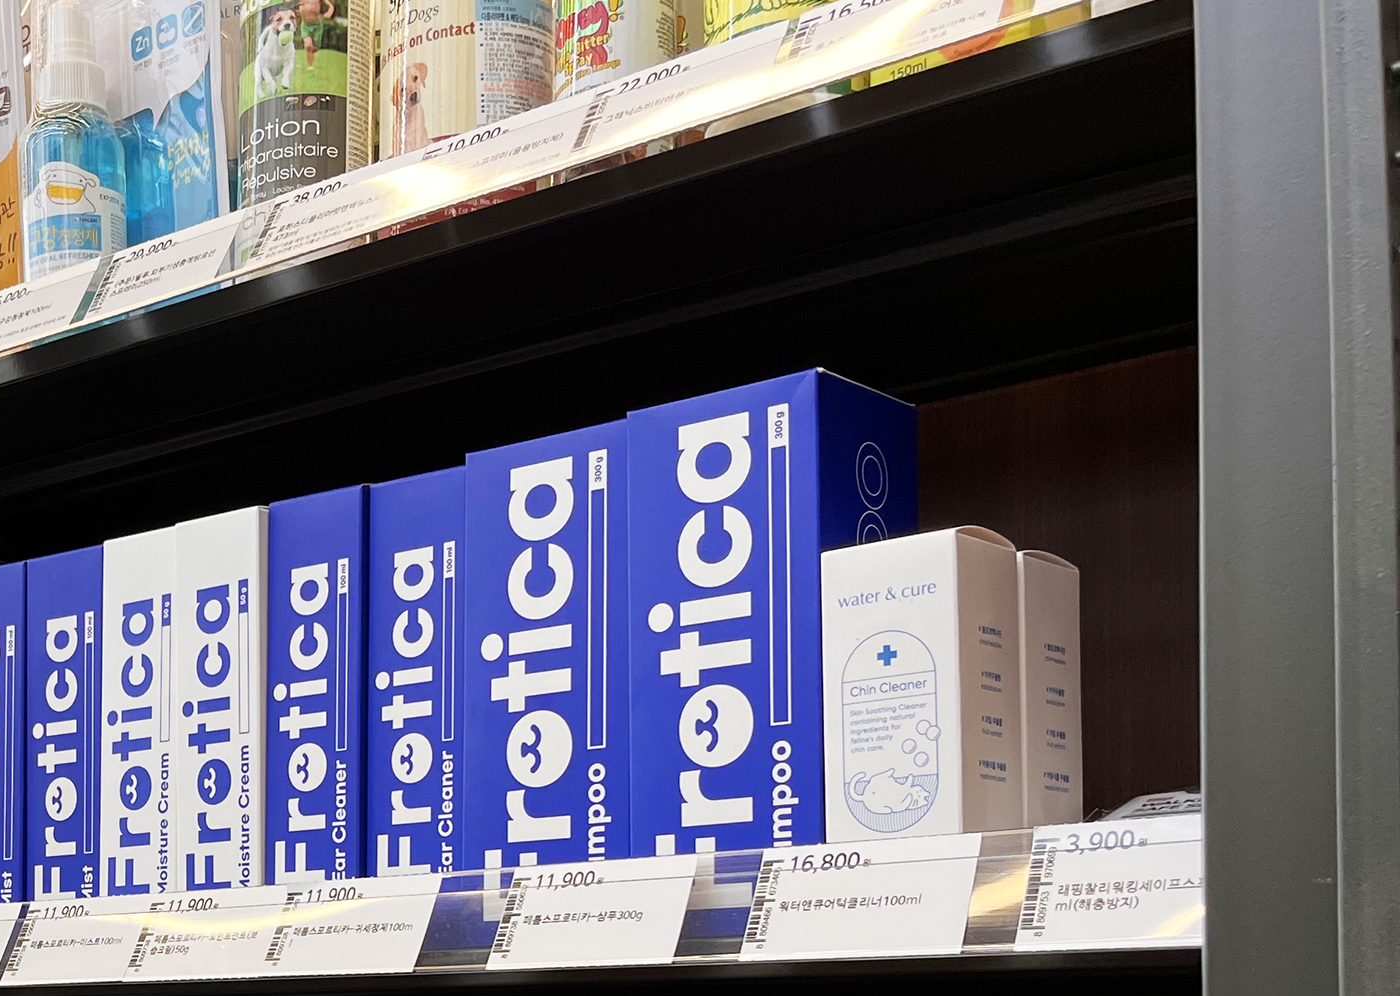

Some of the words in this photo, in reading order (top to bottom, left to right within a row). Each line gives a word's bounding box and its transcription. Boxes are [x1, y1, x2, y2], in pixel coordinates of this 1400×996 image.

[407, 4, 440, 27] Dogs
[135, 36, 150, 54] Zn
[410, 35, 423, 48] on
[426, 22, 476, 43] Contact
[889, 58, 928, 81] 150ml
[240, 118, 321, 154] Lotion
[238, 142, 339, 175] ntiparasitaire
[773, 421, 785, 440] 300
[339, 573, 348, 591] 100
[838, 590, 881, 609] water
[885, 586, 898, 601] &
[901, 581, 937, 599] cure
[850, 684, 878, 699] Chin
[879, 678, 928, 695] Cleaner
[273, 561, 330, 886] Frotica
[374, 545, 435, 877] Frotica
[850, 708, 864, 718] Skin
[865, 705, 897, 717] Soothing
[898, 701, 928, 711] Cleaner
[850, 715, 888, 727] containing
[889, 711, 916, 723] natural
[182, 583, 233, 892] Frotica
[850, 723, 889, 736] ingredients
[890, 722, 902, 731] for
[850, 736, 875, 746] feline's
[876, 733, 893, 744] daily
[32, 614, 79, 902] Frotica
[107, 597, 155, 898] Frotica
[850, 745, 864, 754] chin
[157, 752, 171, 813] Cream
[238, 744, 251, 806] Cream
[437, 750, 455, 839] Cleaner
[156, 815, 170, 896] Moisture
[437, 842, 454, 875] Ear
